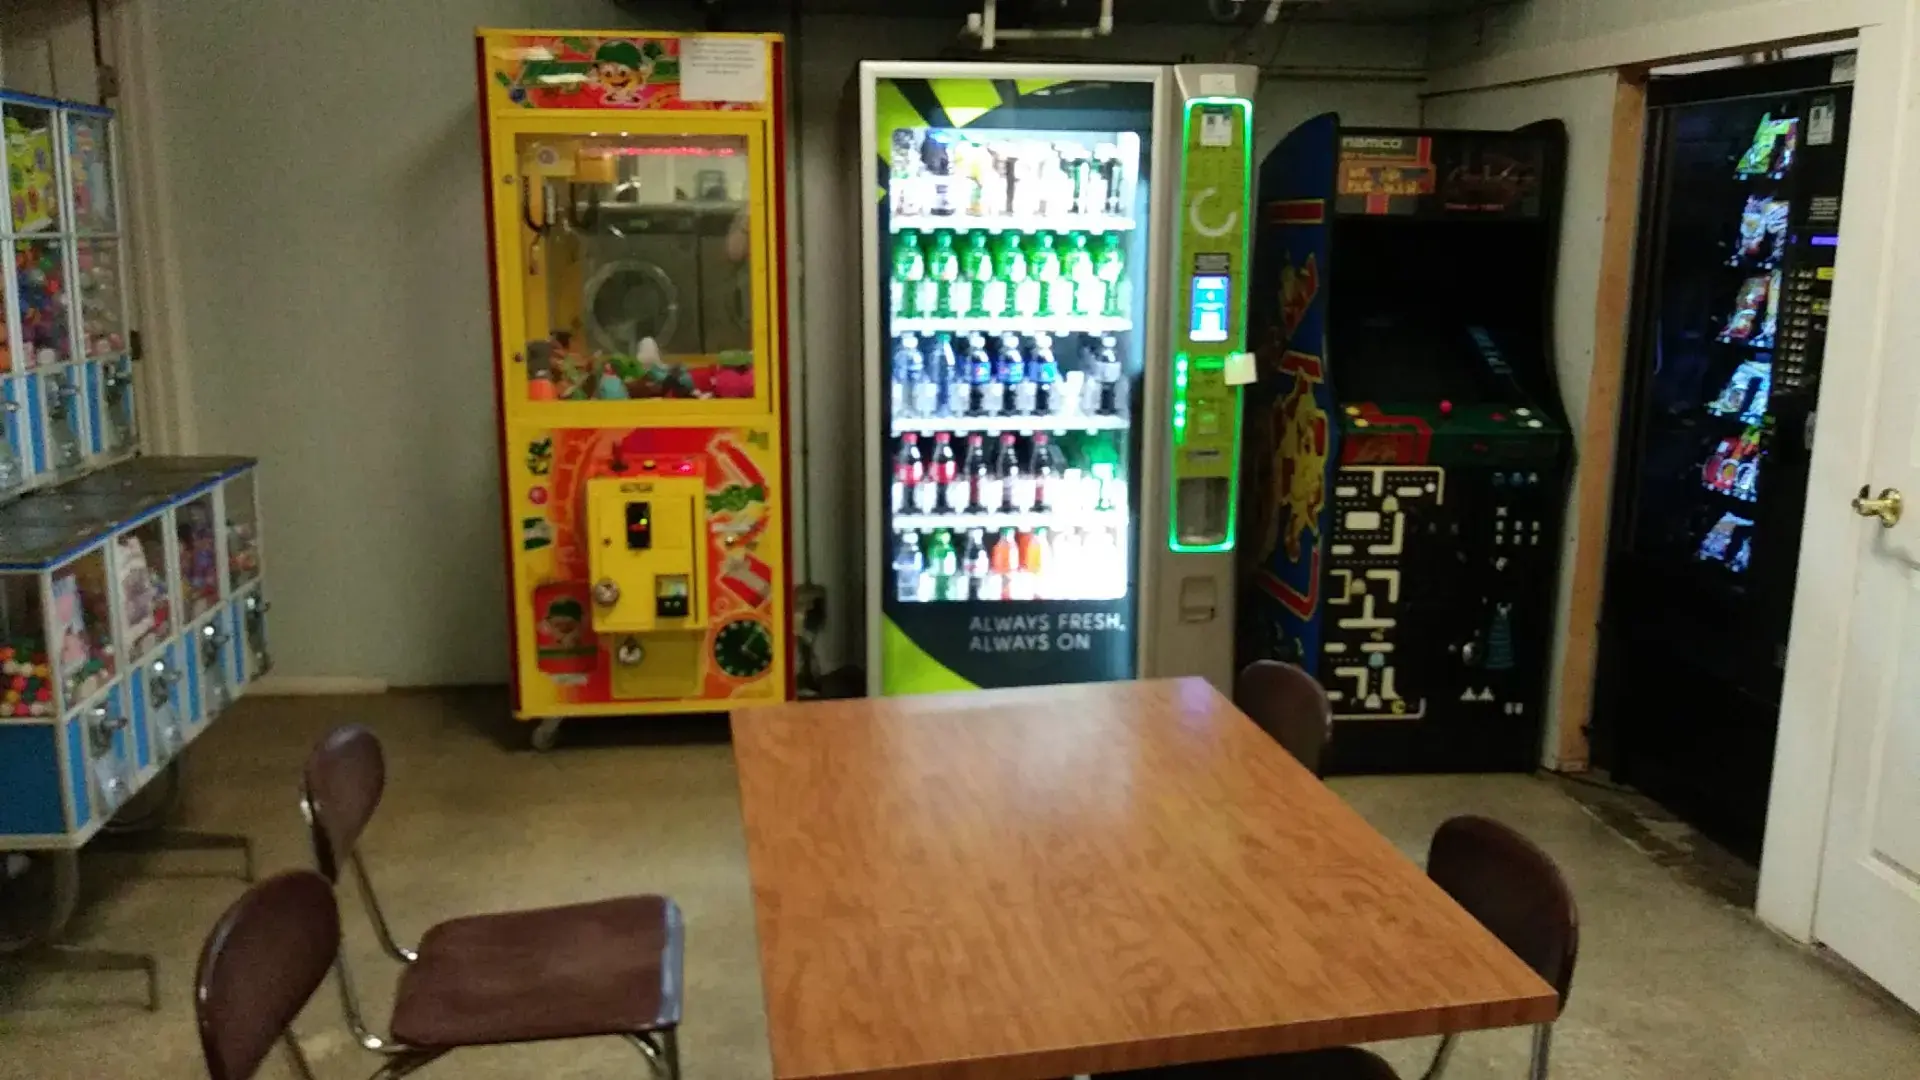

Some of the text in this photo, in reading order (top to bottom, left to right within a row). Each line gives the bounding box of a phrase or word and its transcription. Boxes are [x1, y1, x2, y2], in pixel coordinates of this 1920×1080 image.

[969, 614, 1050, 632] ALWAYS
[969, 632, 1091, 652] ALWAYS ON
